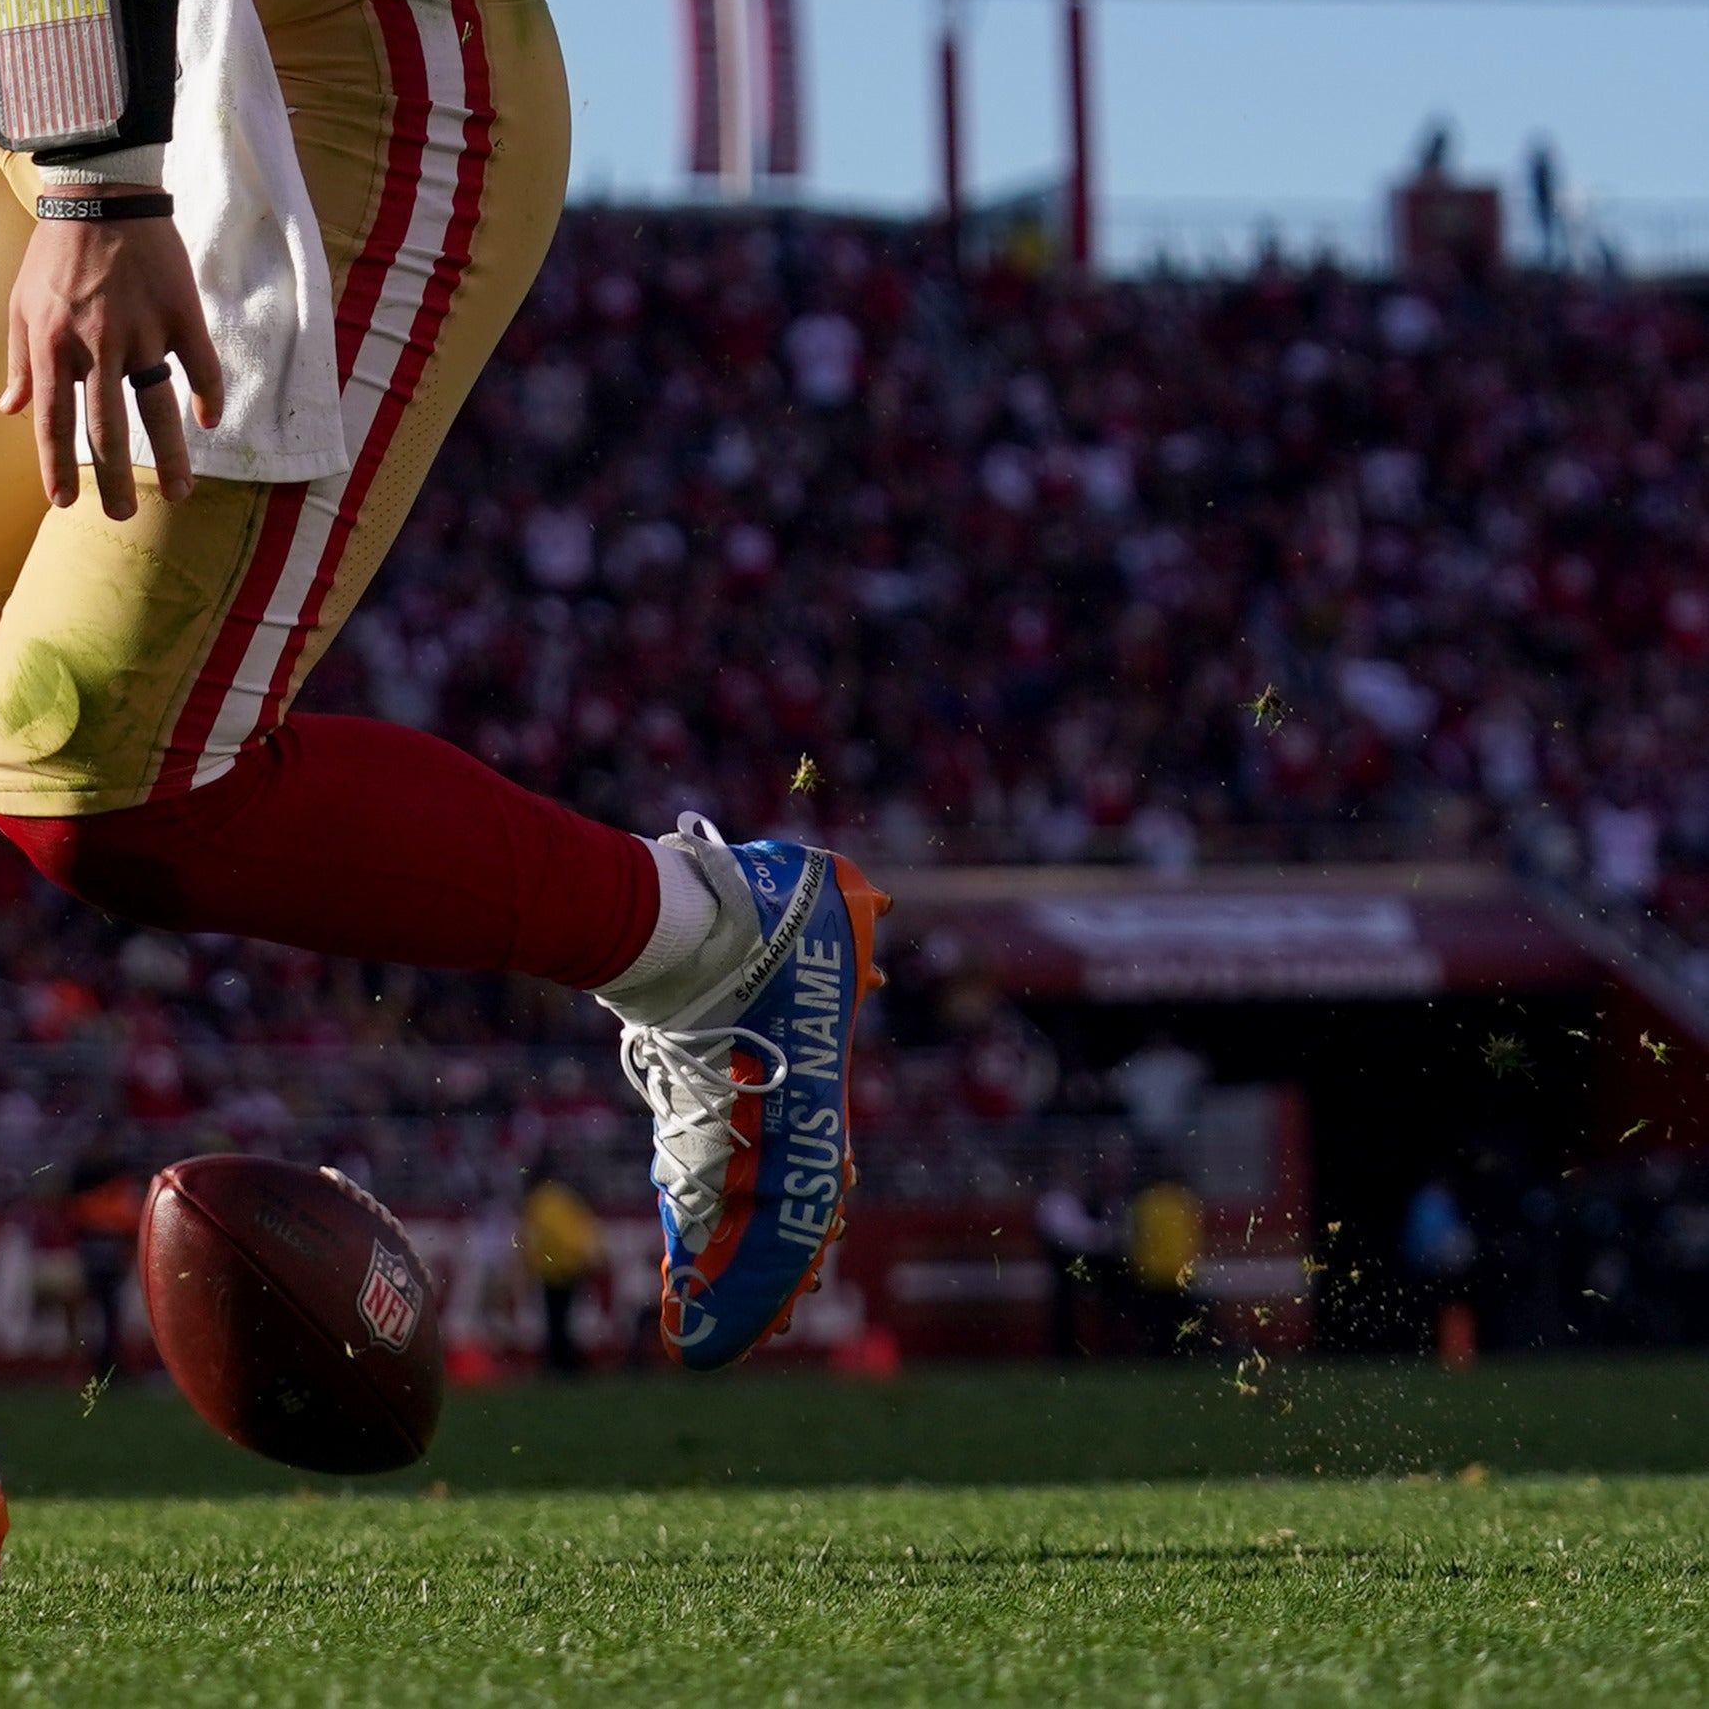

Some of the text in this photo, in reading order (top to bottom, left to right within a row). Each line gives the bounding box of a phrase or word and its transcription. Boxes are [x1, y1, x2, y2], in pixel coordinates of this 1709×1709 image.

[735, 896, 811, 1002] SAMARITAN'S
[802, 851, 825, 899] PURSE
[791, 935, 841, 1080] NAME
[364, 1274, 411, 1344] NFL
